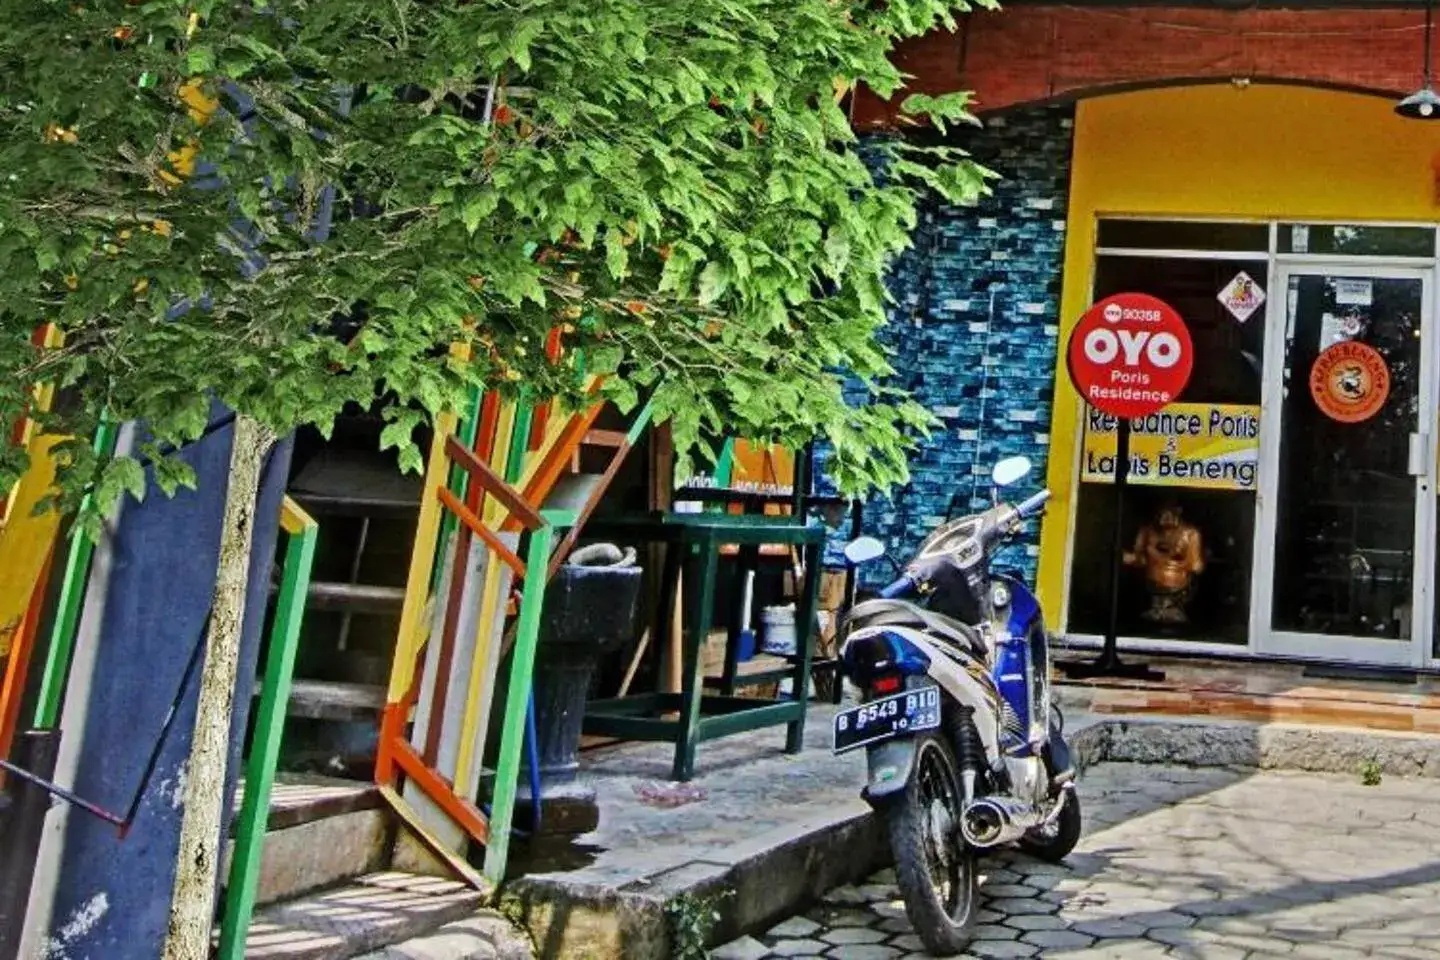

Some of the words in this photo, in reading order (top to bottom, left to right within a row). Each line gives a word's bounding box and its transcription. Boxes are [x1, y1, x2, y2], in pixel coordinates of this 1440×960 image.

[1084, 328, 1182, 368] OYO
[1111, 370, 1150, 385] Poris
[1089, 385, 1170, 402] Residence
[1209, 410, 1258, 438] Poris
[1088, 451, 1149, 475] Lais
[1159, 455, 1256, 486] Beneng
